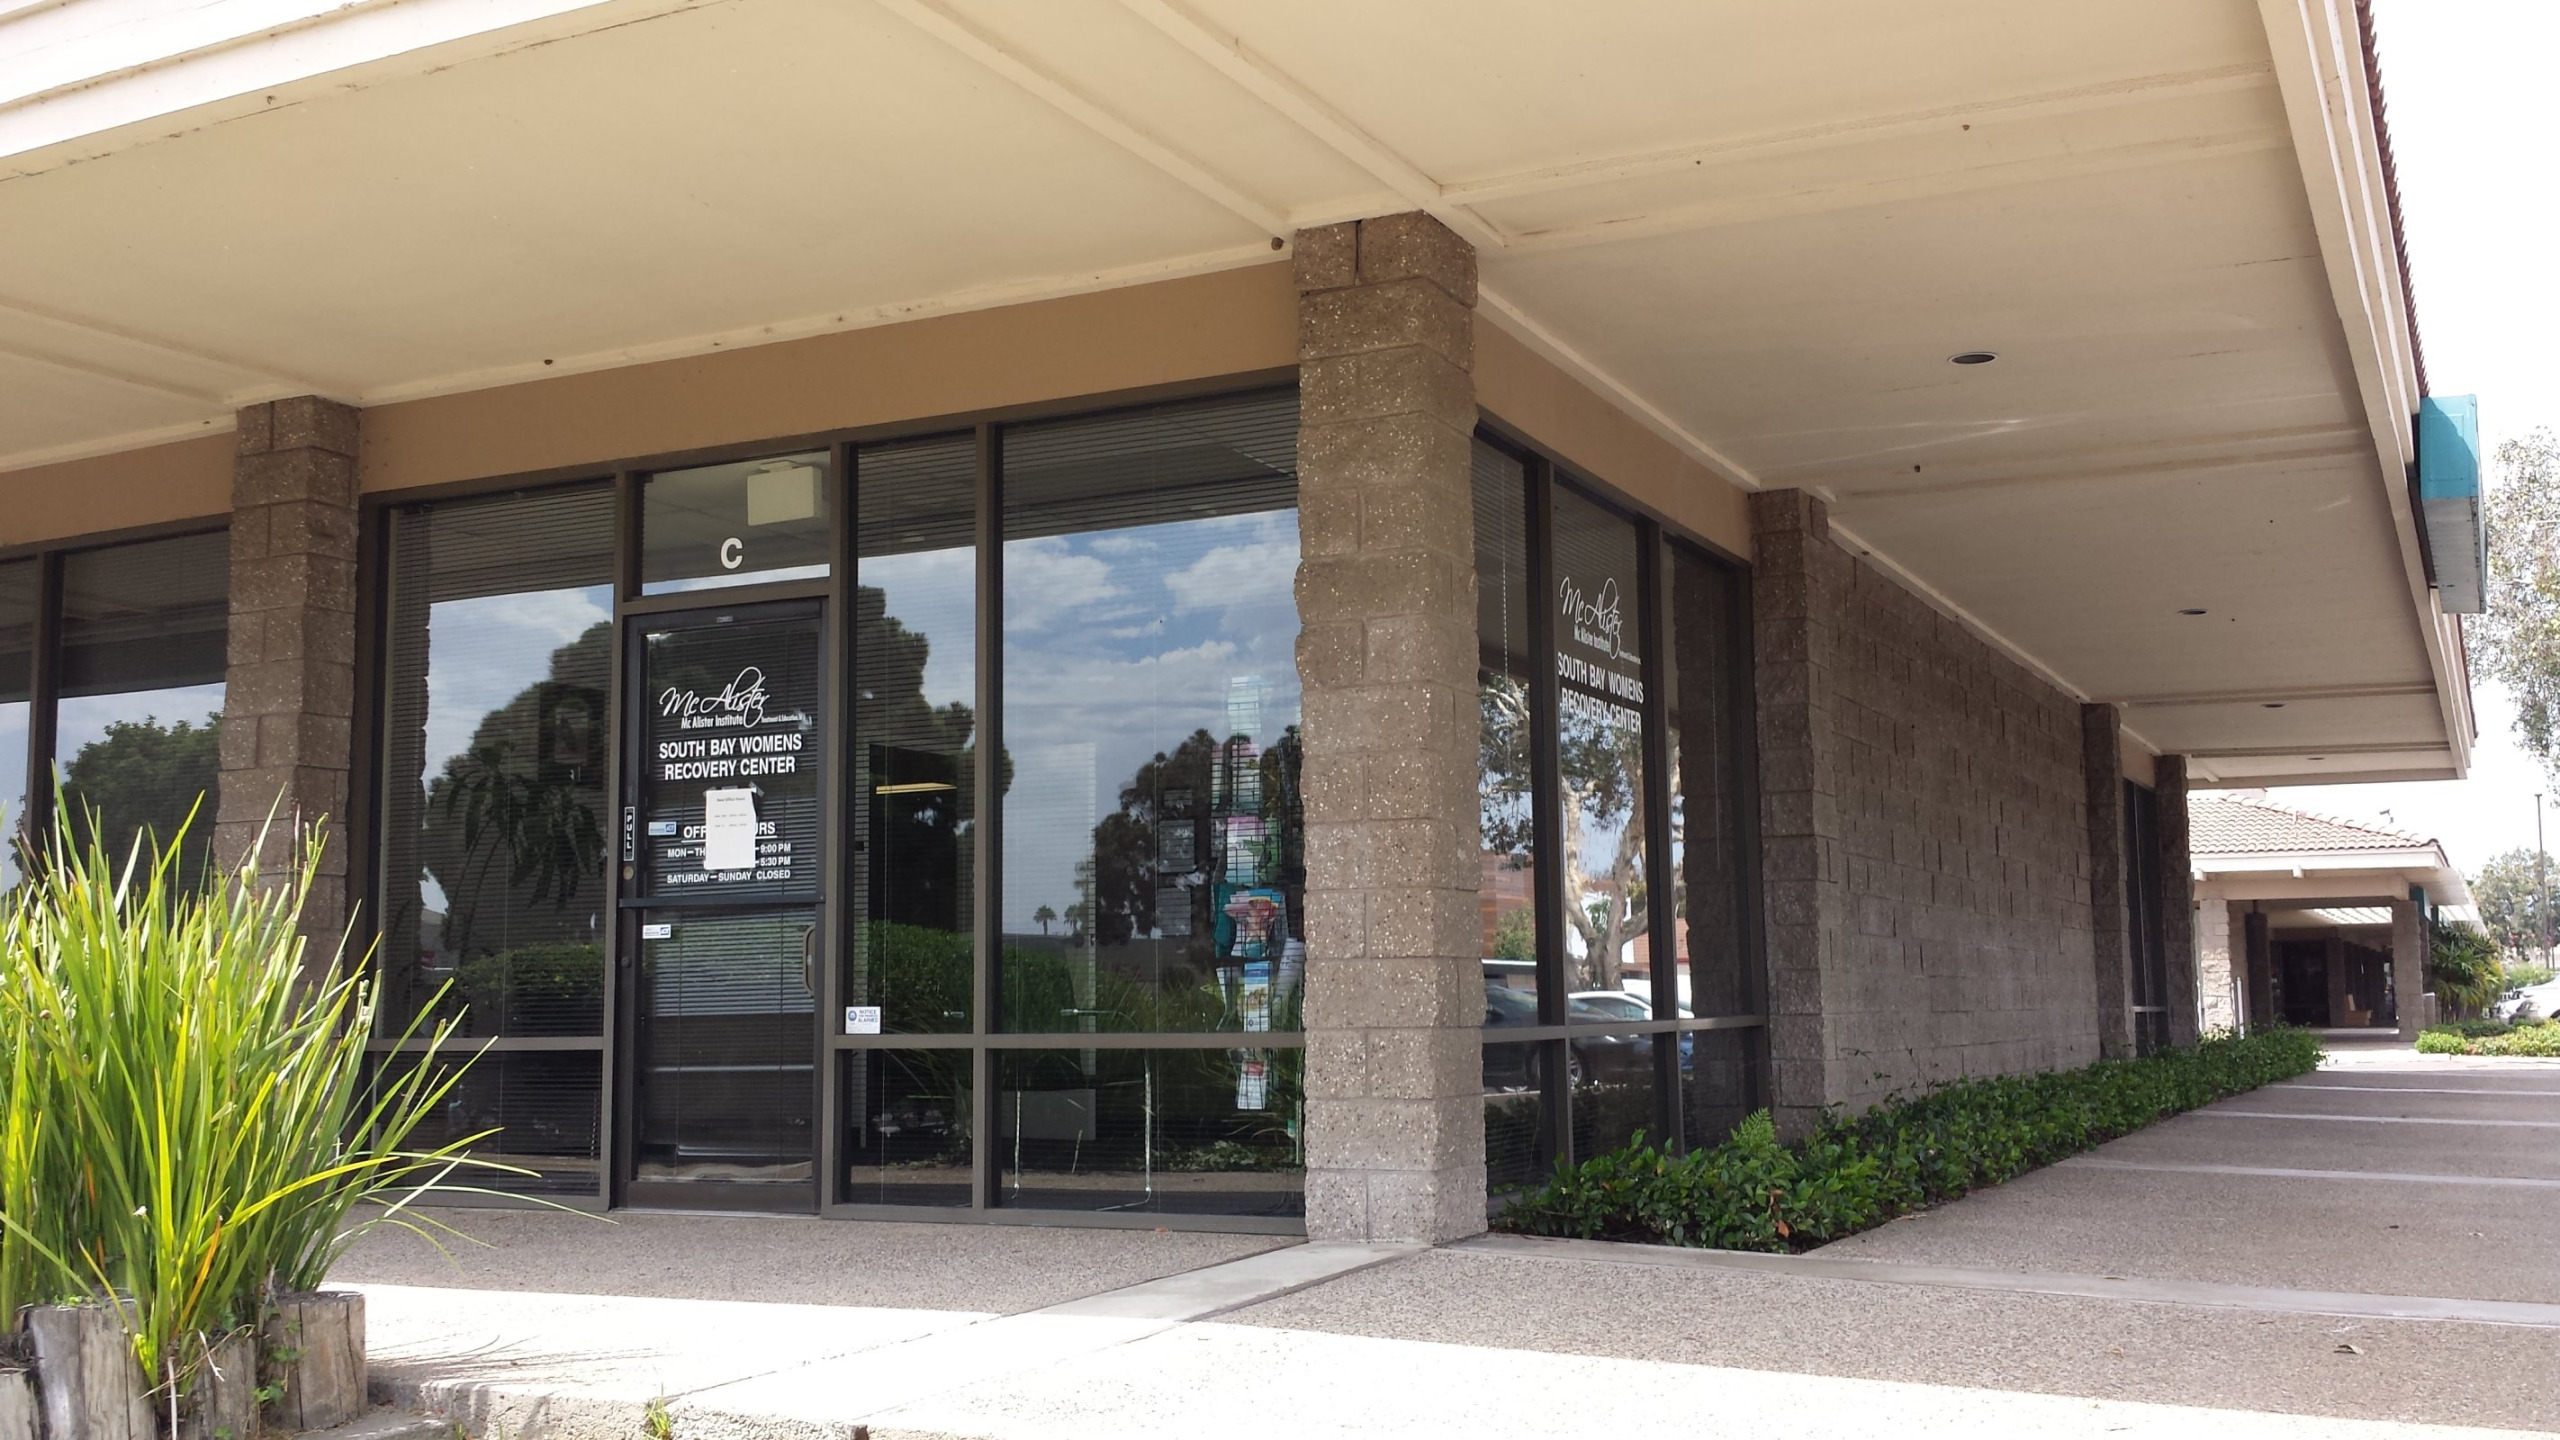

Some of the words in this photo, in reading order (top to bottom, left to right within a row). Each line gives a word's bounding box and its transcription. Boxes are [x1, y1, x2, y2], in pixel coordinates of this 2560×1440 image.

[720, 537, 743, 570] C
[1557, 651, 1587, 685] SOUTH
[1589, 664, 1606, 691] BAY
[1608, 670, 1644, 704] WOMENS
[659, 687, 699, 717] Mc
[1560, 687, 1607, 722] RECOVERY
[1609, 703, 1642, 734] CENTER
[681, 717, 691, 729] Mc
[692, 715, 714, 728] Alister
[715, 714, 743, 727] Institute
[659, 740, 706, 759] SOUTH
[710, 737, 737, 756] BAY
[739, 733, 802, 754] WOMENS
[664, 759, 737, 781] RECOVERY
[740, 756, 796, 776] CENTER
[683, 825, 707, 839] OFF
[667, 847, 706, 858] MON-TH
[778, 843, 791, 852] PM
[778, 856, 791, 865] PM
[756, 869, 791, 880] CLOSED
